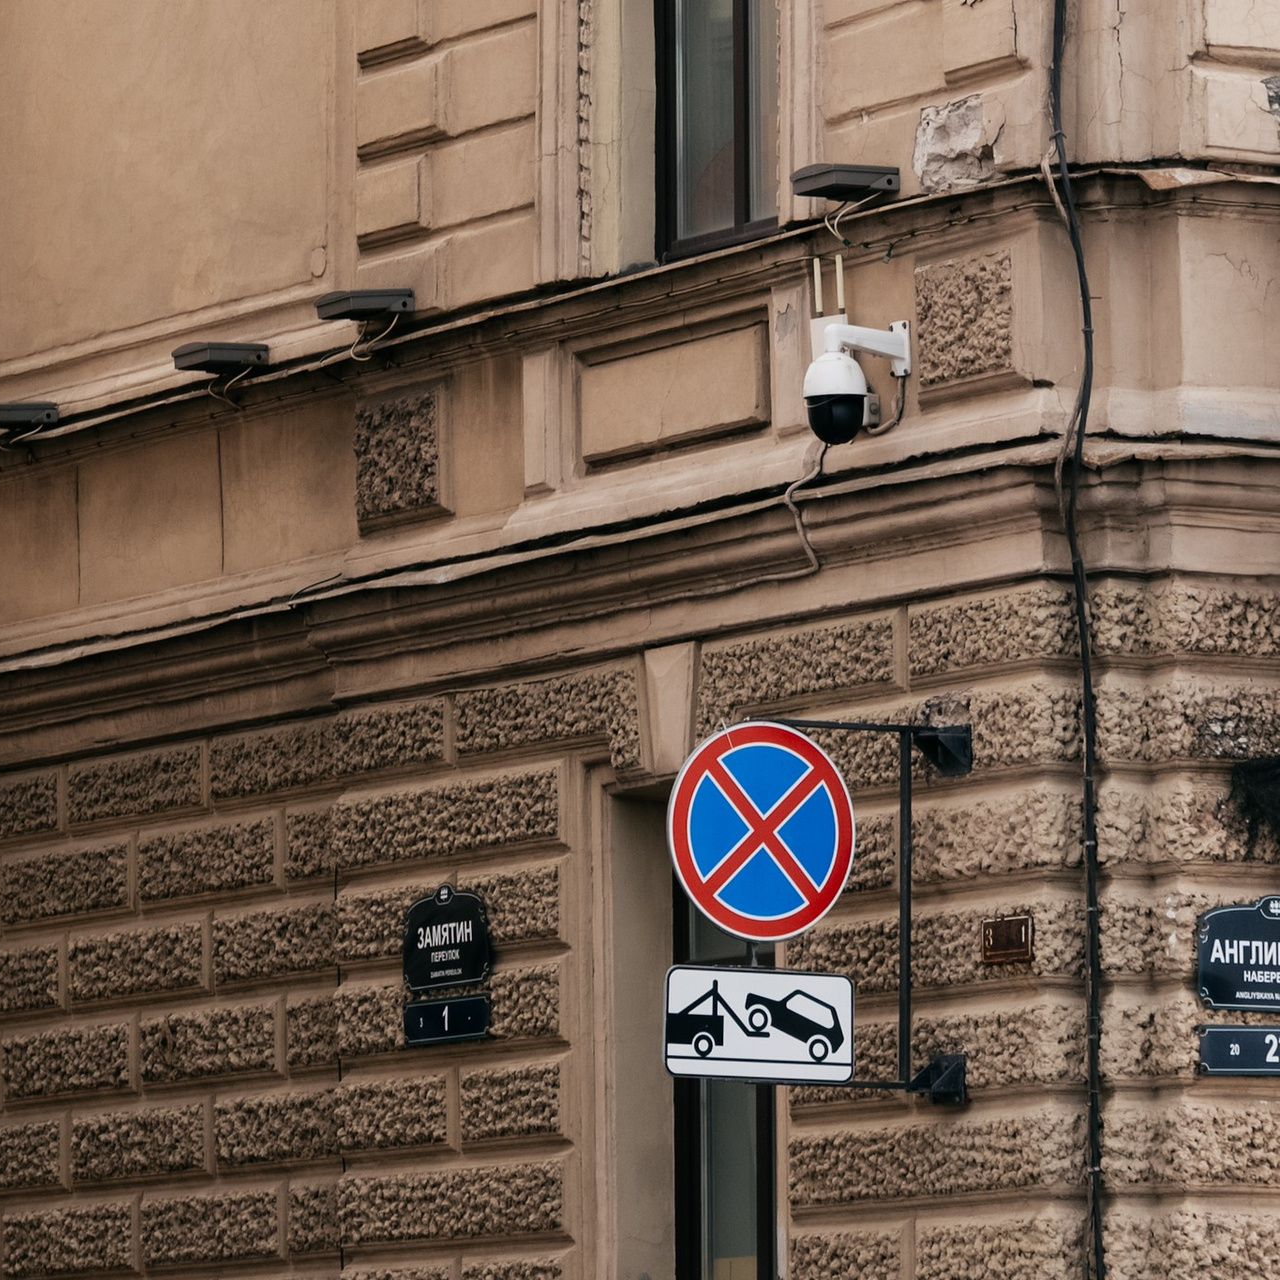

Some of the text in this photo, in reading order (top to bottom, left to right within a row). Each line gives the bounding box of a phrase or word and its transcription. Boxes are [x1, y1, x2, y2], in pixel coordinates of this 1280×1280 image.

[417, 920, 472, 949] ЗАМЯТИН
[431, 949, 460, 963] ПЕРЕУЛОК
[1210, 939, 1280, 966] АНГЛИ
[442, 1005, 449, 1031] 1
[1229, 1033, 1280, 1063] 20 2
